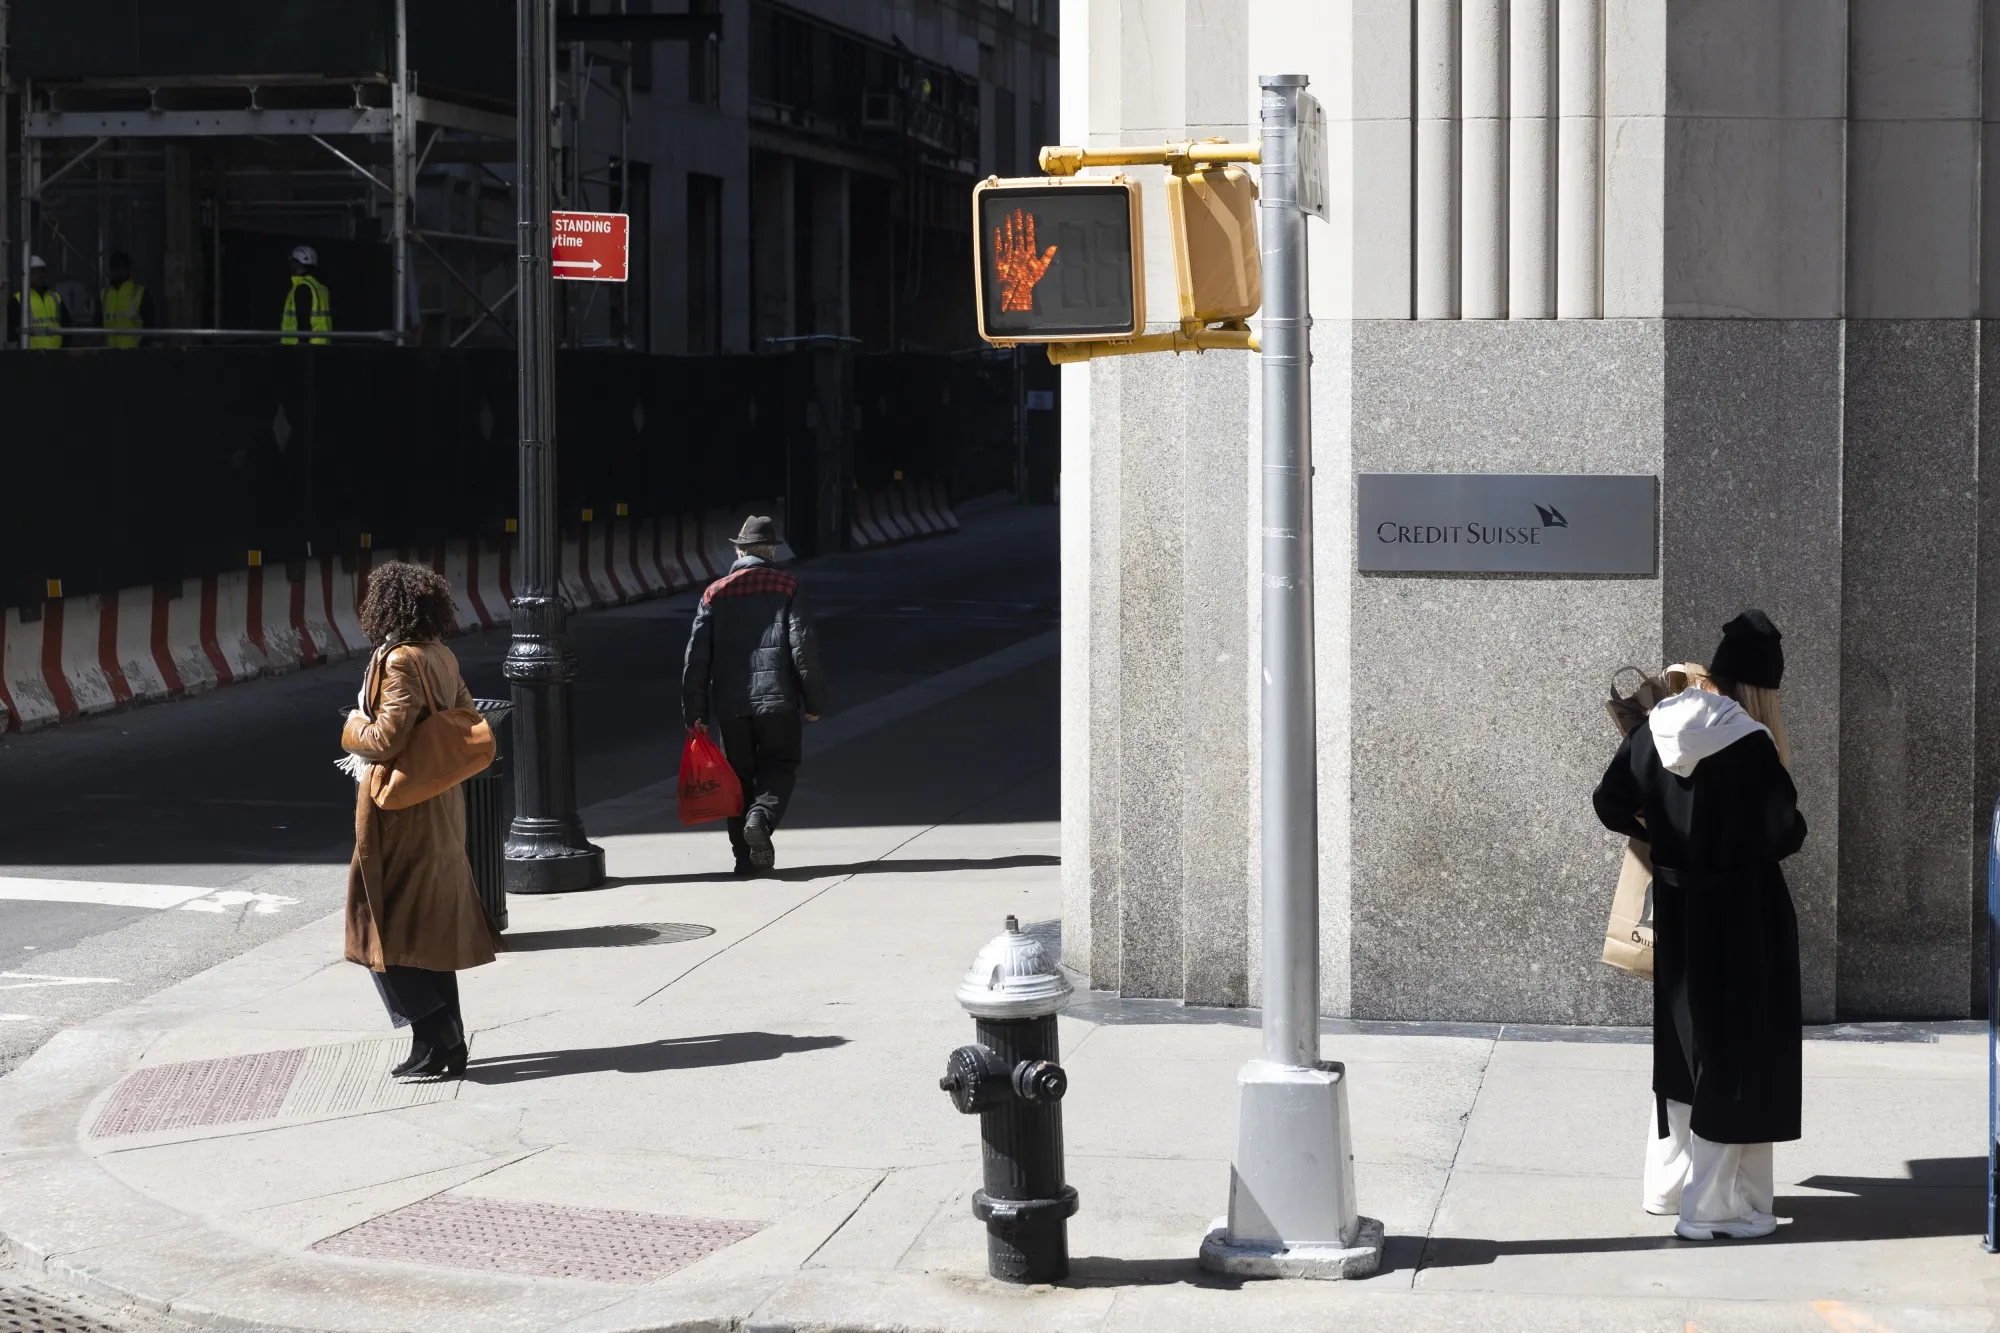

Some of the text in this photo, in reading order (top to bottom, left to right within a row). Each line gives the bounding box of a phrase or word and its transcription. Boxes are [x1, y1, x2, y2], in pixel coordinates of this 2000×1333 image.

[555, 219, 611, 233] STANDING
[1377, 522, 1541, 545] CREDIT SUISSE
